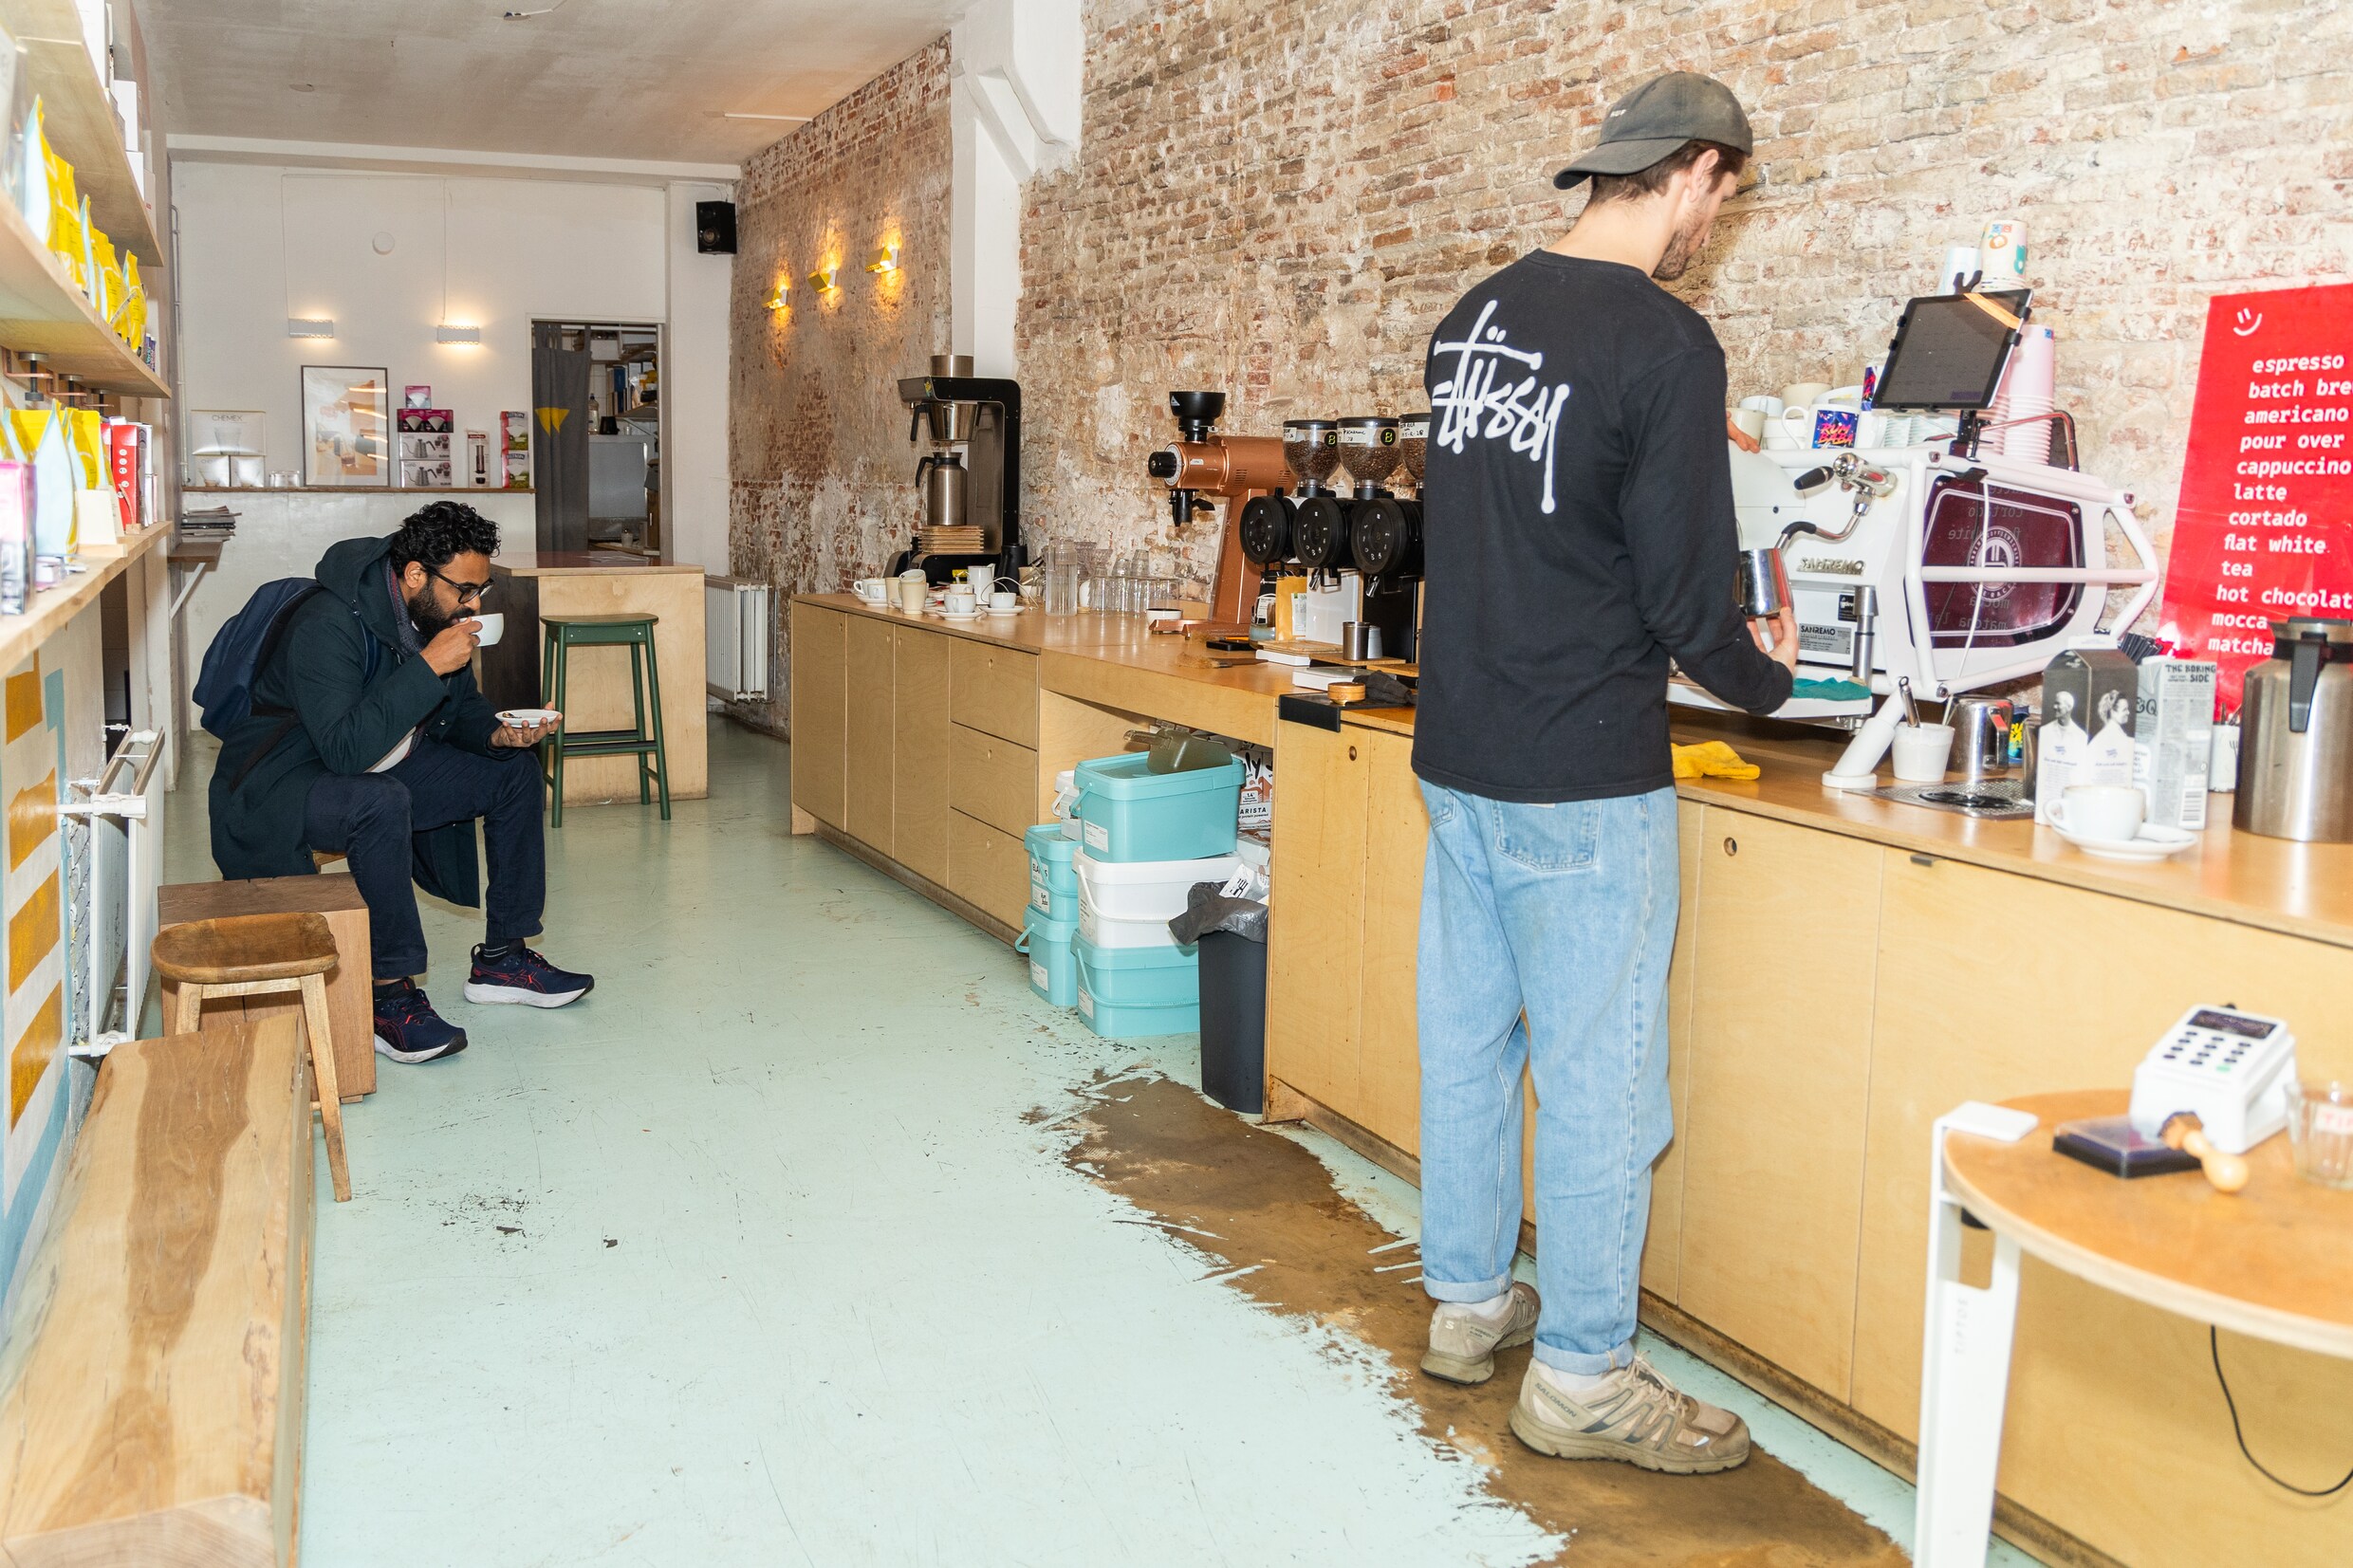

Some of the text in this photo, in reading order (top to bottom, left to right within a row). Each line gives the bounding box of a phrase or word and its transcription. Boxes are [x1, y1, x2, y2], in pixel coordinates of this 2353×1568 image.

[2251, 355, 2344, 377] espresso
[2248, 378, 2353, 399] batch bre
[2244, 404, 2349, 424] americano
[1821, 422, 1851, 434] RUM
[1818, 433, 1854, 446] BABA
[2239, 434, 2345, 453] pour over
[2236, 455, 2352, 479] cappuccino
[2233, 482, 2288, 502] latte
[2228, 508, 2307, 527] cortado
[2224, 532, 2326, 555] flat white
[2221, 560, 2253, 578] tea
[2215, 583, 2353, 610] hot chocolat
[1800, 625, 1836, 636] SANREMO
[2211, 613, 2268, 630] mocca
[2207, 636, 2274, 655] matcha
[2165, 664, 2216, 673] THE BORING
[2190, 673, 2210, 683] SIDE
[1239, 806, 1267, 815] ARISTA
